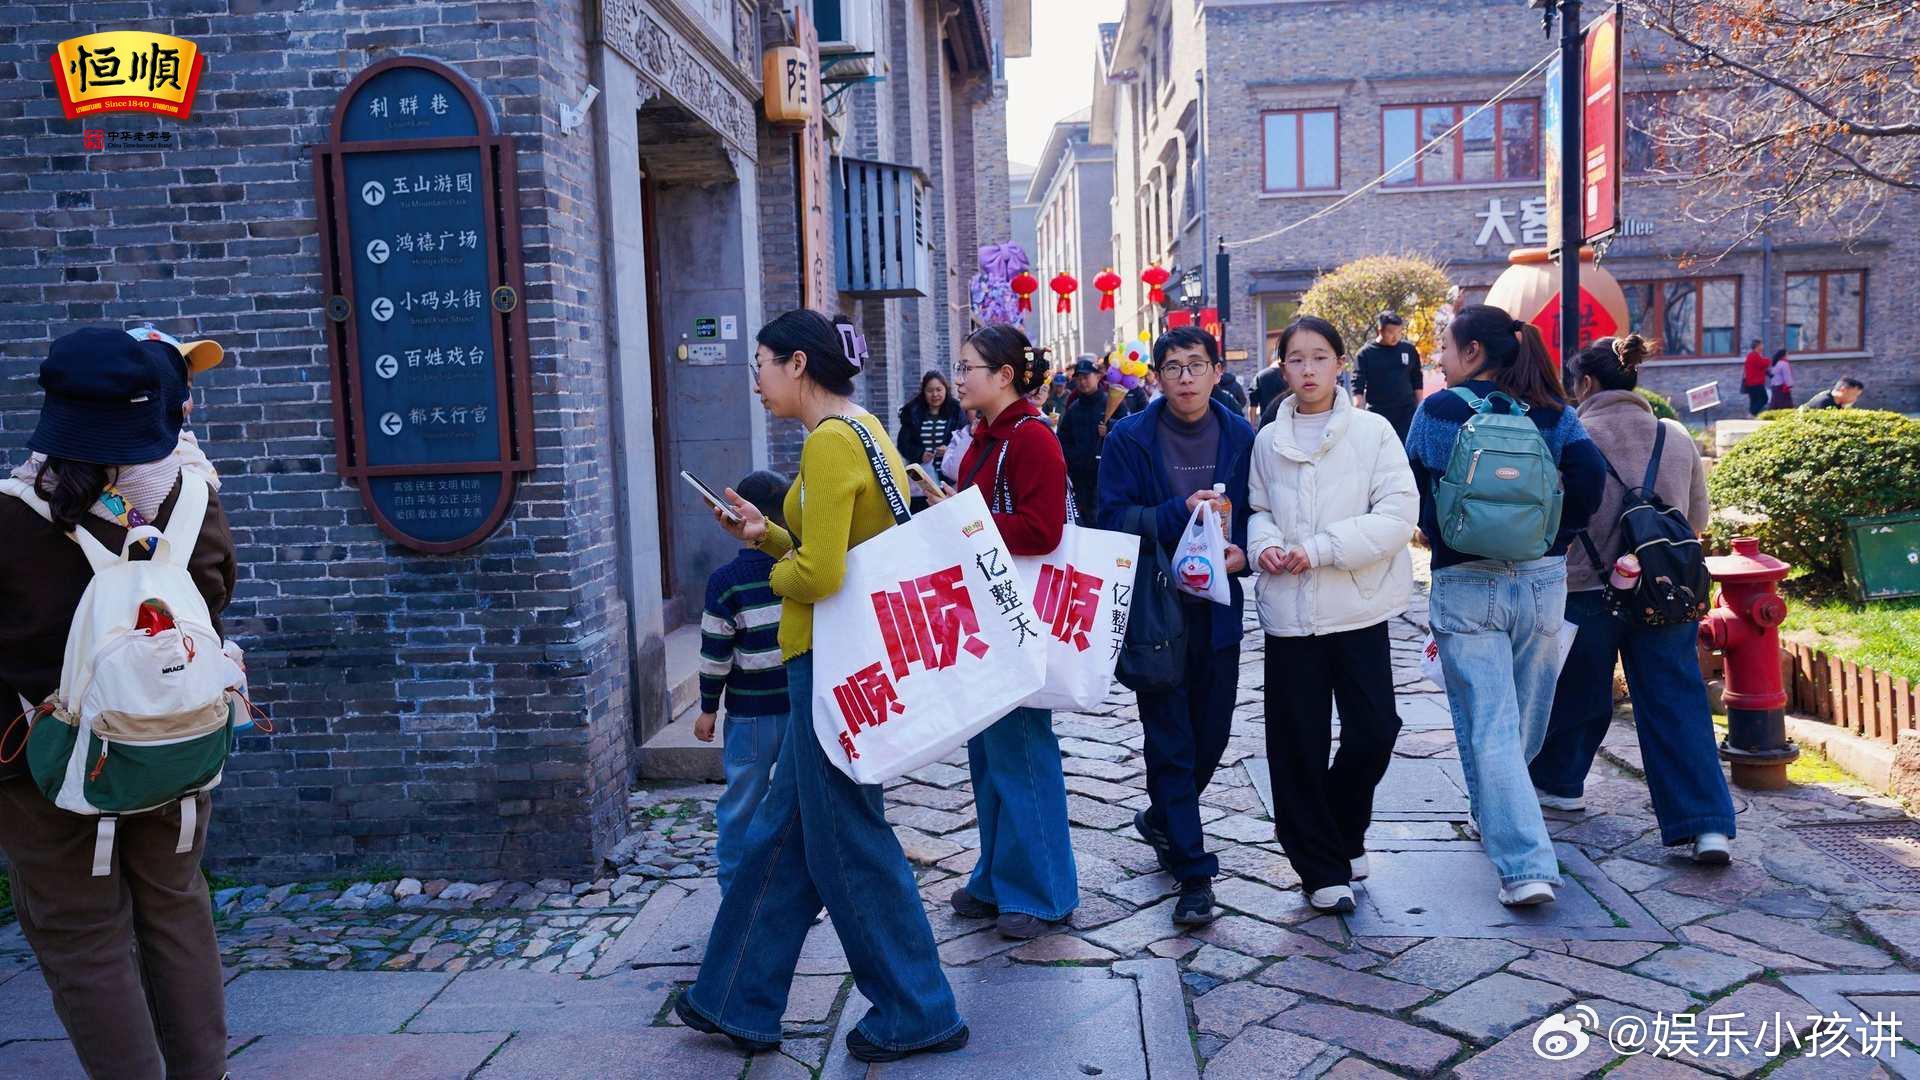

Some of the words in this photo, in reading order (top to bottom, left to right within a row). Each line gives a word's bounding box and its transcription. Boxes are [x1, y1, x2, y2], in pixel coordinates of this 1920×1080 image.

[369, 93, 449, 118] 利群巷
[392, 172, 473, 196] 玉山游园
[395, 230, 478, 252] 鸿禧广场
[400, 289, 482, 311] 小码头街
[404, 346, 485, 368] 百姓戏台
[408, 406, 489, 425] 都天行宫
[416, 480, 435, 491] 民主
[438, 479, 458, 490] 文明
[871, 456, 889, 486] HENG
[884, 486, 905, 516] SHUN
[439, 494, 459, 504] 公正
[975, 545, 1039, 648] 亿整天
[1032, 562, 1105, 653] 顺
[870, 563, 991, 684] 顺
[832, 660, 906, 735] 顺
